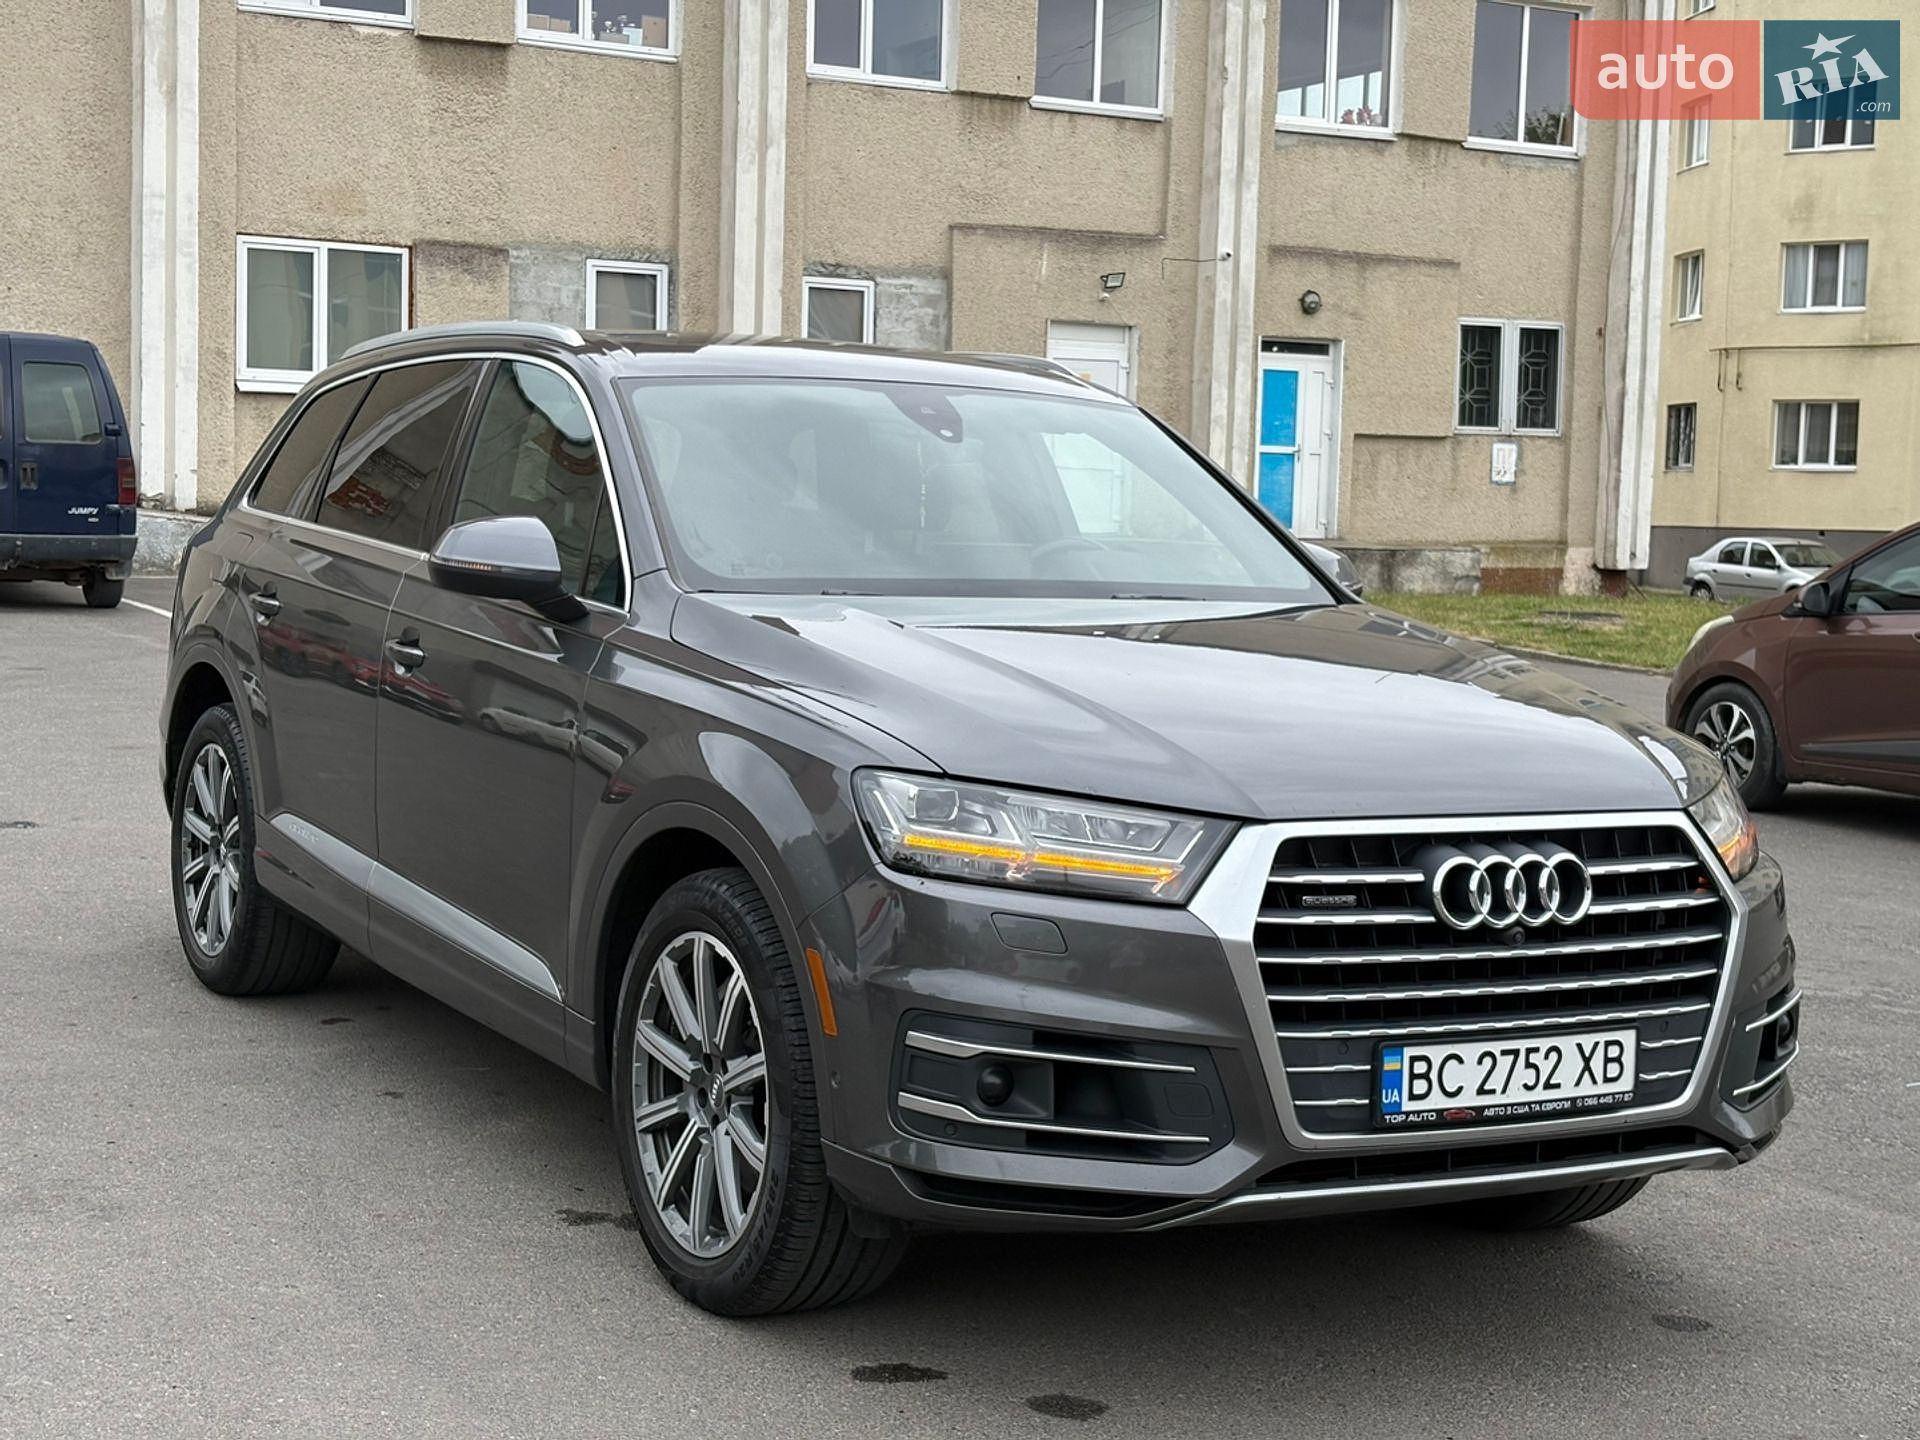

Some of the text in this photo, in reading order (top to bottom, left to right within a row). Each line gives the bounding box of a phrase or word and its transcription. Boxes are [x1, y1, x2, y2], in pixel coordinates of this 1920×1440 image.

[68, 507, 99, 515] JUMPY
[1408, 1039, 1624, 1101] BC 2752 XB
[1382, 1089, 1400, 1104] UA
[1384, 1112, 1436, 1123] TOP AUTO
